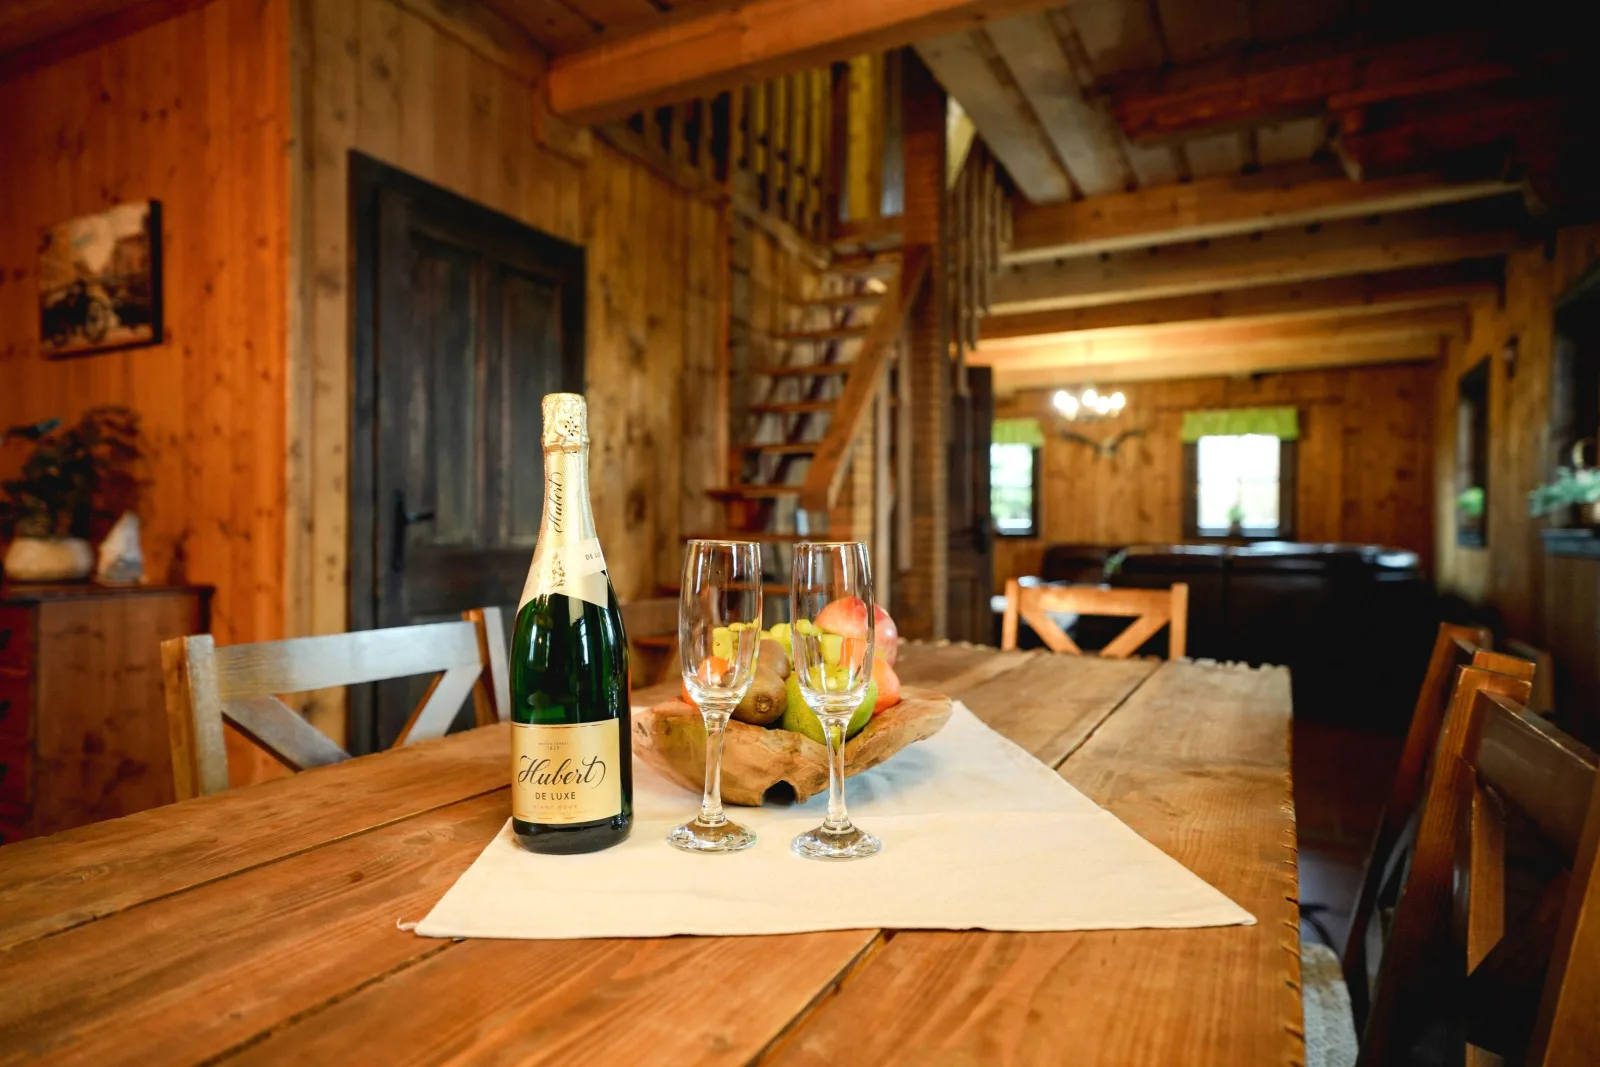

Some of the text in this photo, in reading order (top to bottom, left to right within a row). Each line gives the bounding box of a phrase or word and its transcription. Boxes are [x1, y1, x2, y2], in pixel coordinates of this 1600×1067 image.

[548, 471, 564, 533] Hubert
[518, 755, 606, 790] Hubert
[535, 791, 576, 801] DE LUXE
